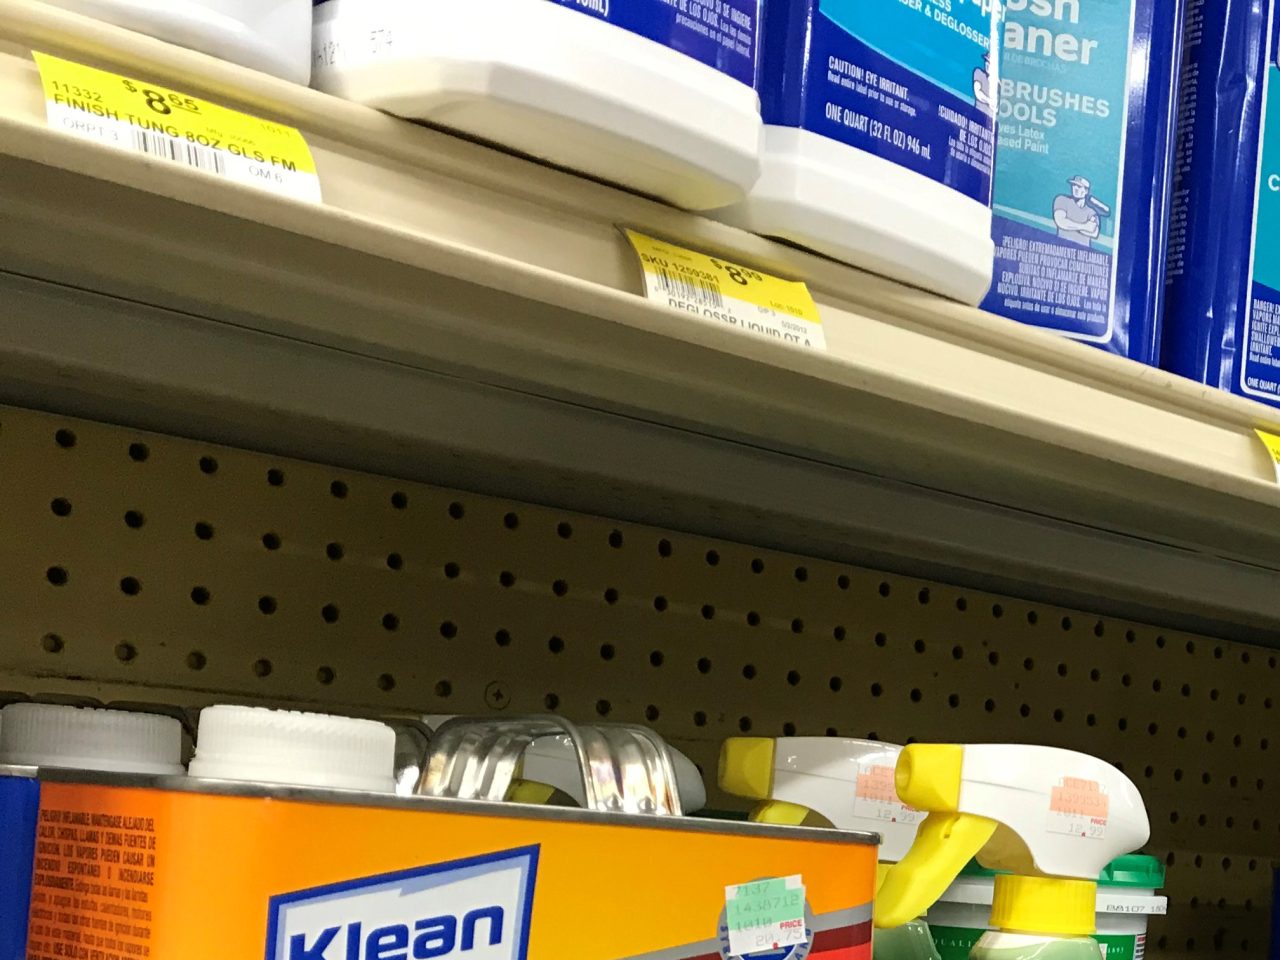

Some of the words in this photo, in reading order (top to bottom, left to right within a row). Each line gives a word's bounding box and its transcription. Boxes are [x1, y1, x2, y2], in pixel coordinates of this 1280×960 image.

[52, 80, 102, 102] 11332
[1000, 79, 1110, 118] BRUSHES
[54, 94, 119, 120] FINISH
[124, 113, 179, 138] TUNG
[228, 144, 264, 163] GLS
[271, 158, 296, 172] FM
[825, 102, 843, 121] ONE
[844, 111, 868, 134] QUART
[869, 119, 884, 138] (32
[884, 125, 892, 143] FL
[893, 129, 905, 148] OZ)
[906, 131, 920, 155] 946
[921, 144, 931, 160] mL
[641, 252, 668, 268] SKU
[780, 919, 802, 929] PRICE
